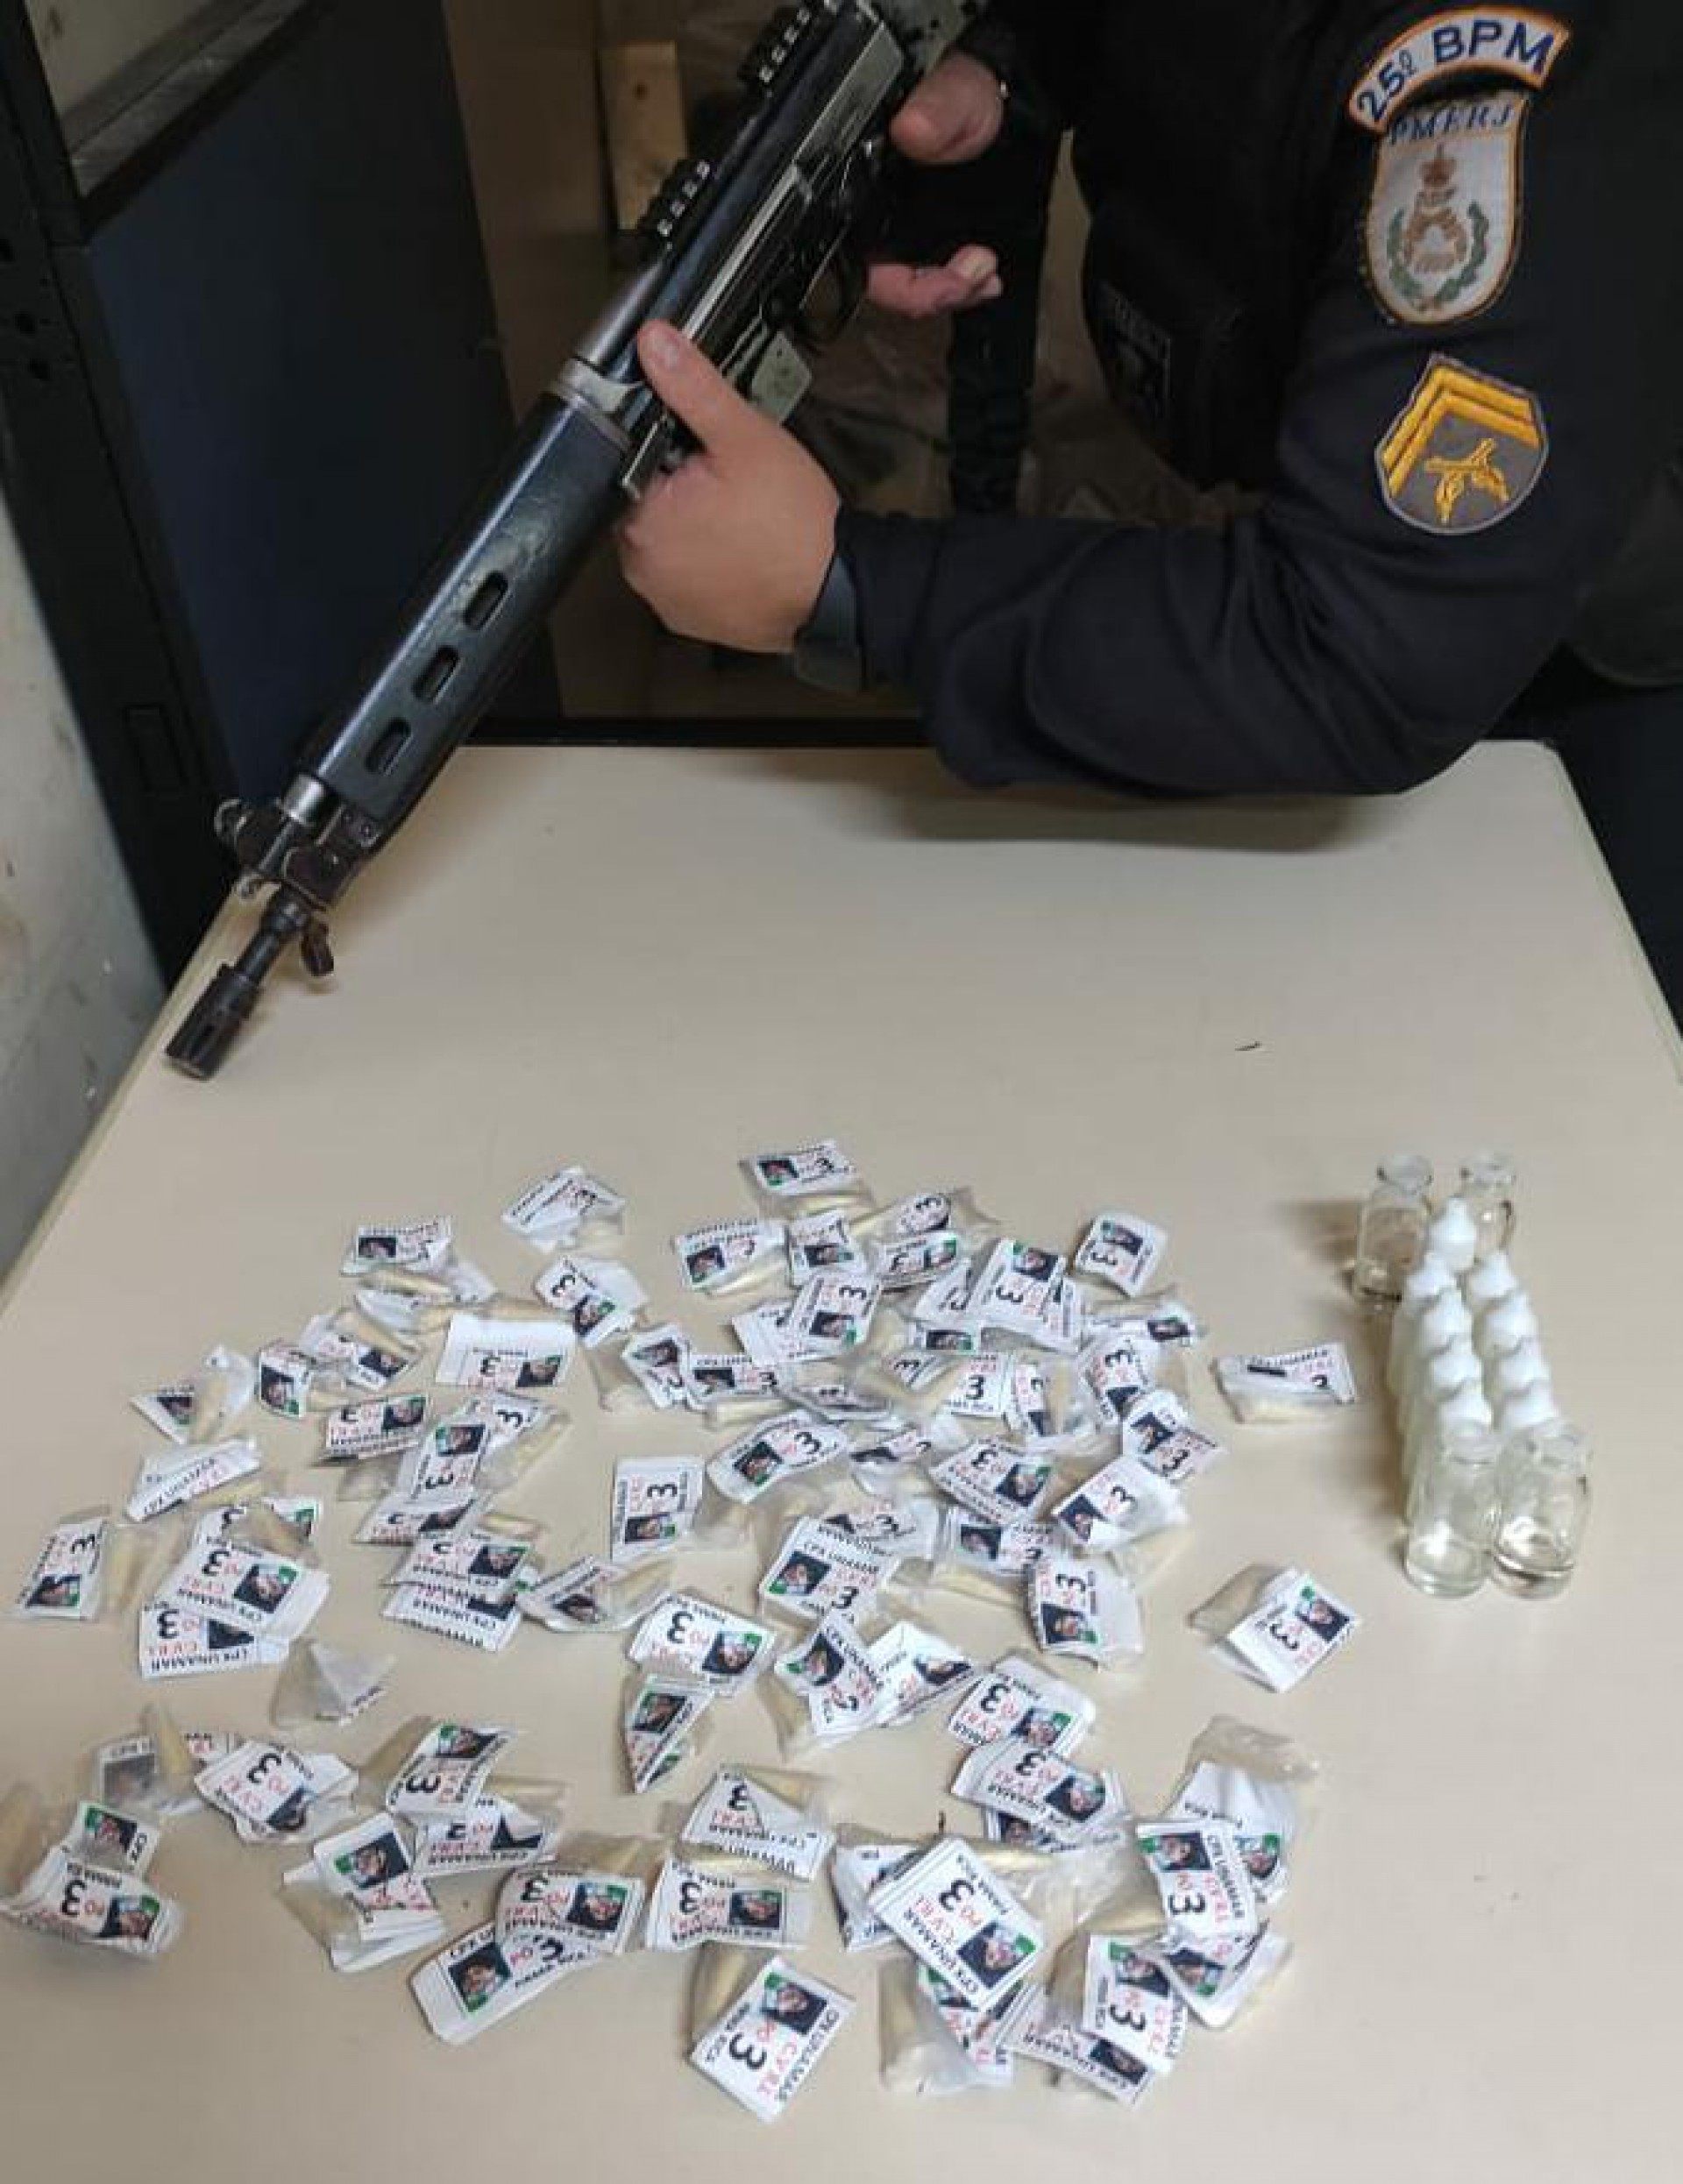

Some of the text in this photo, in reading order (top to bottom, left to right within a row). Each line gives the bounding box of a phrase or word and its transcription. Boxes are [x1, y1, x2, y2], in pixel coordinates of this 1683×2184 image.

[1432, 19, 1555, 75] BPM
[839, 1285, 868, 1301] 3
[966, 1373, 985, 1401] 3
[496, 1408, 524, 1430] 3
[793, 1431, 822, 1454] 3
[647, 1482, 678, 1499] 3
[201, 1549, 230, 1577] 3
[1055, 1572, 1087, 1592] 3
[831, 1585, 861, 1610] 3
[156, 1609, 180, 1639] 3
[666, 1610, 694, 1644] 3
[1269, 1622, 1299, 1650] 3
[980, 1682, 1012, 1712] 3
[245, 1753, 282, 1784] 3
[1014, 1750, 1047, 1776] 3
[405, 1775, 442, 1794] 3
[60, 1879, 87, 1917] 3
[520, 1875, 550, 1903] 3
[678, 1881, 703, 1913] 3
[937, 1878, 976, 1912] 3
[1167, 1892, 1207, 1917] 3
[1109, 2003, 1147, 2032] 3
[728, 2032, 768, 2071] 3
